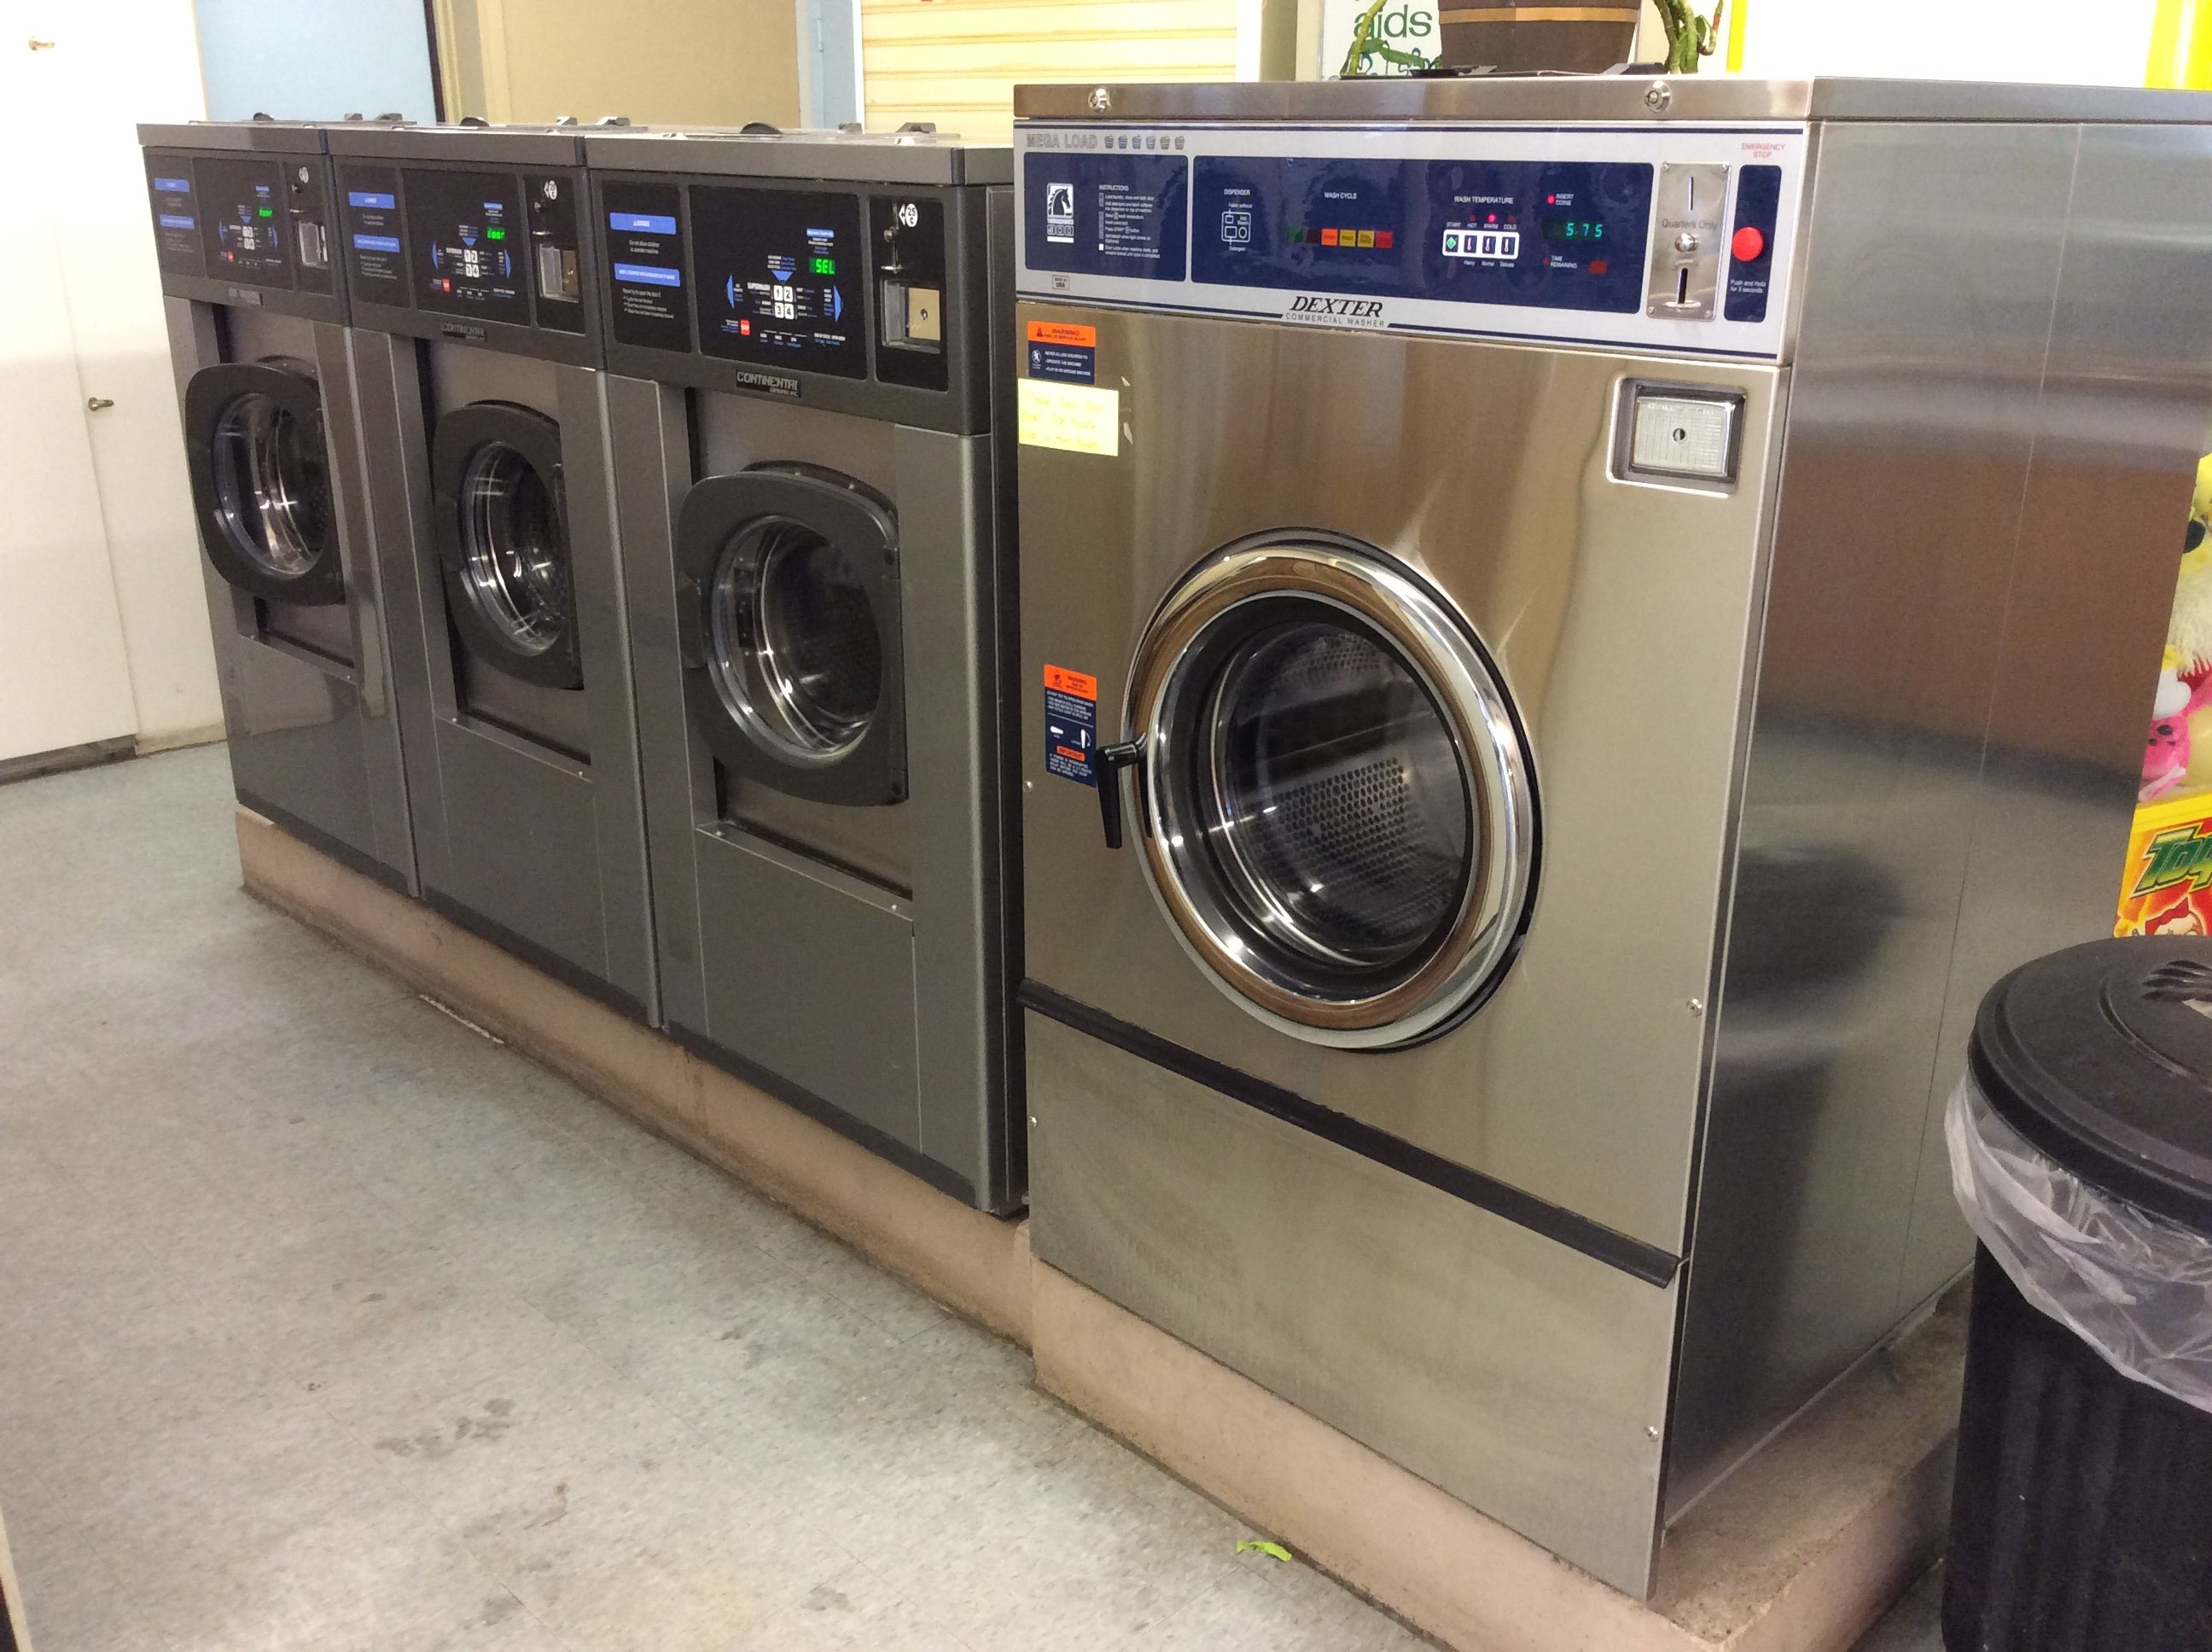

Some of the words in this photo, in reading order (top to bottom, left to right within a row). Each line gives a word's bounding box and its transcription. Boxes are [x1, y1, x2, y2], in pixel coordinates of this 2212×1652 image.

[1027, 134, 1060, 148] MEGA
[1064, 134, 1097, 148] LOAD
[908, 207, 915, 216] 25
[1662, 218, 1697, 230] Quarters
[816, 259, 835, 274] SEL
[1289, 295, 1383, 317] DEXTER
[1285, 312, 1342, 324] COMMERCIAL
[1347, 317, 1385, 327] WASHER
[736, 371, 800, 391] CONTINENTAL
